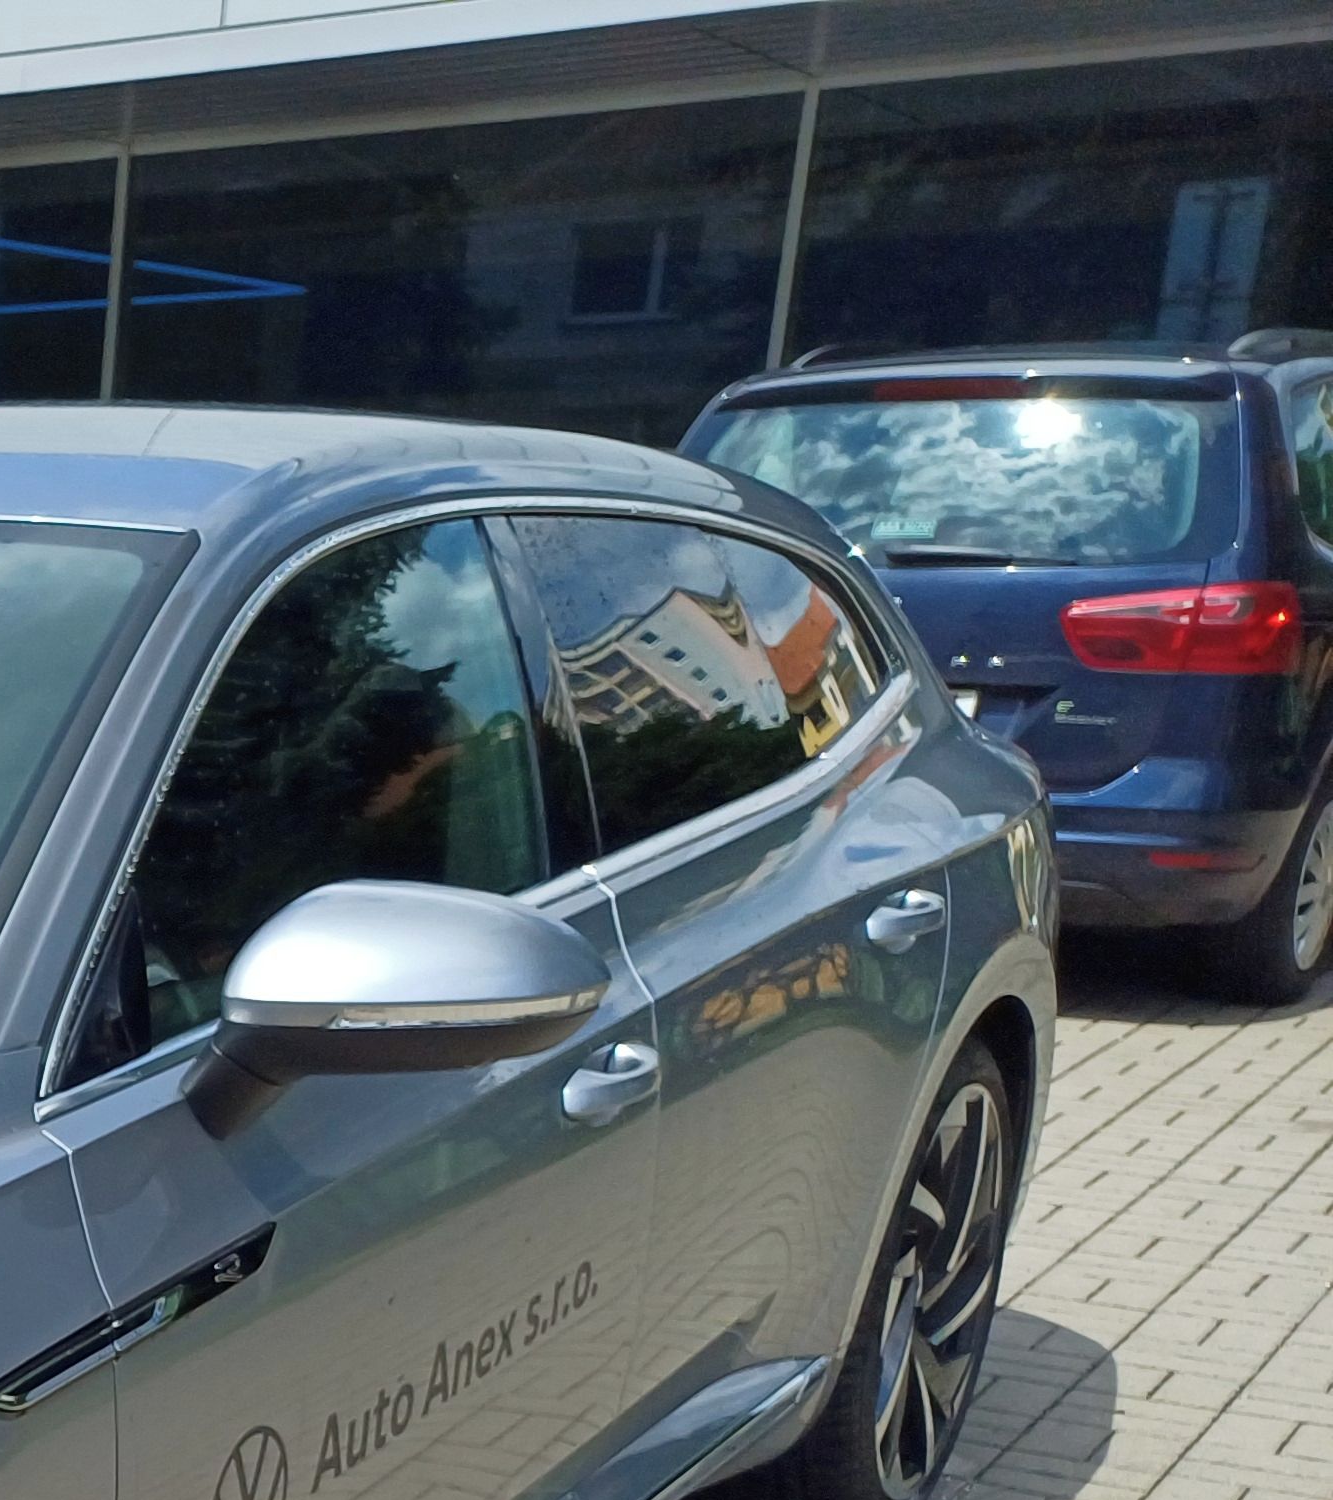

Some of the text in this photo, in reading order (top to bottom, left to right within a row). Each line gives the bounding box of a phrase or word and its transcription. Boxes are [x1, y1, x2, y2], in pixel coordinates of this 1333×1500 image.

[309, 1261, 599, 1494] Auto Anex s.r.o.
